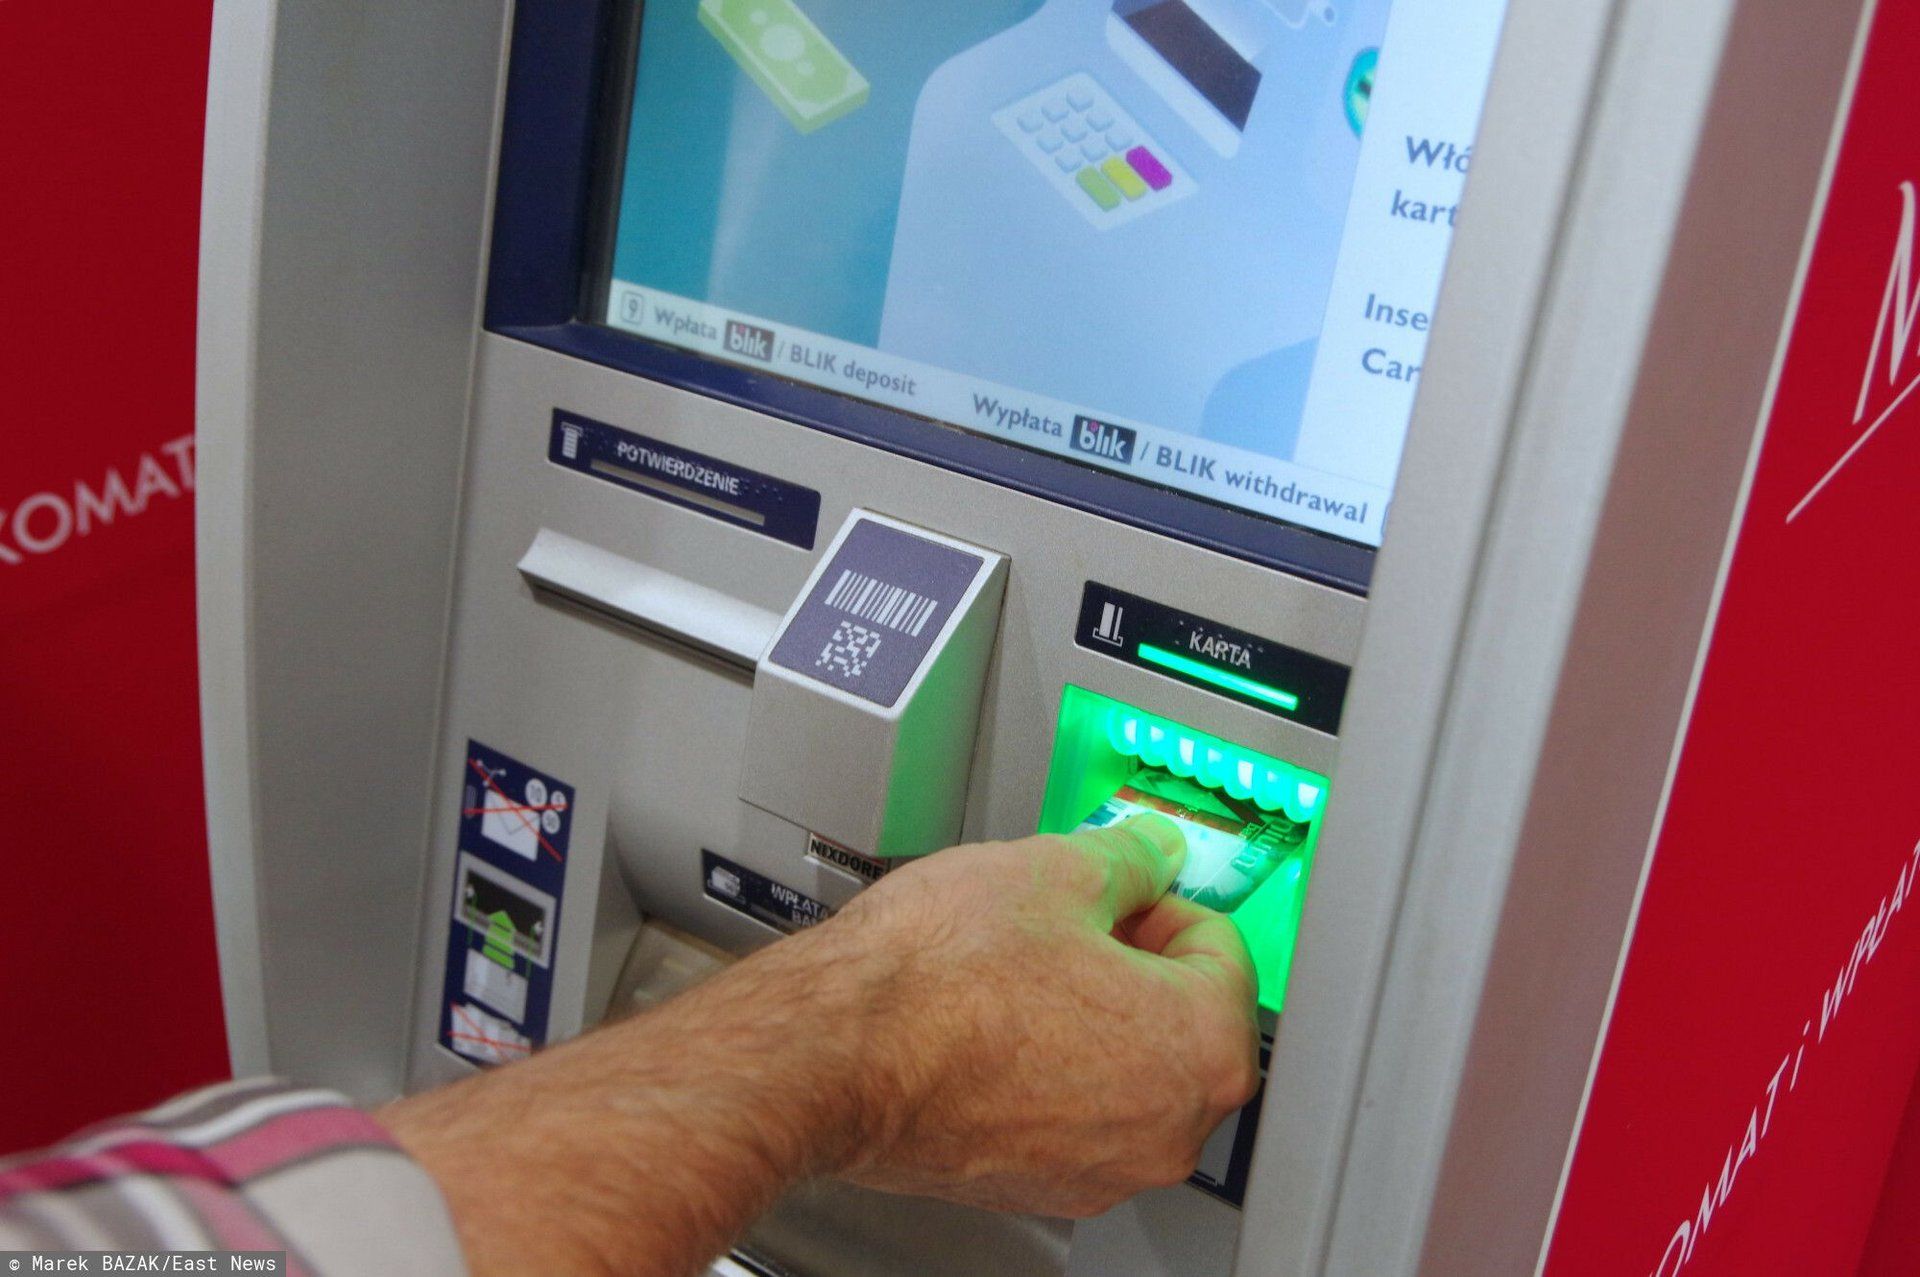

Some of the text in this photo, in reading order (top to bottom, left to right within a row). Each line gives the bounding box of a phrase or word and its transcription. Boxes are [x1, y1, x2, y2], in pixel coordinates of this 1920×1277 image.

[1364, 293, 1429, 332] Inse
[626, 299, 640, 322] 9
[654, 304, 718, 342] Wpłata
[727, 324, 772, 359] blik
[790, 343, 836, 373] BLIK
[843, 358, 918, 396] deposit
[1361, 348, 1422, 383] Car
[616, 440, 742, 496] POTWIERDZENIE
[973, 392, 1064, 438] Wypłata
[1077, 419, 1130, 462] blik
[1156, 445, 1218, 480] BLIK
[1225, 467, 1368, 523] withdrawal
[1189, 630, 1252, 669] KARTA
[1648, 1052, 1791, 1277] OMAT
[1789, 1019, 1811, 1093] i
